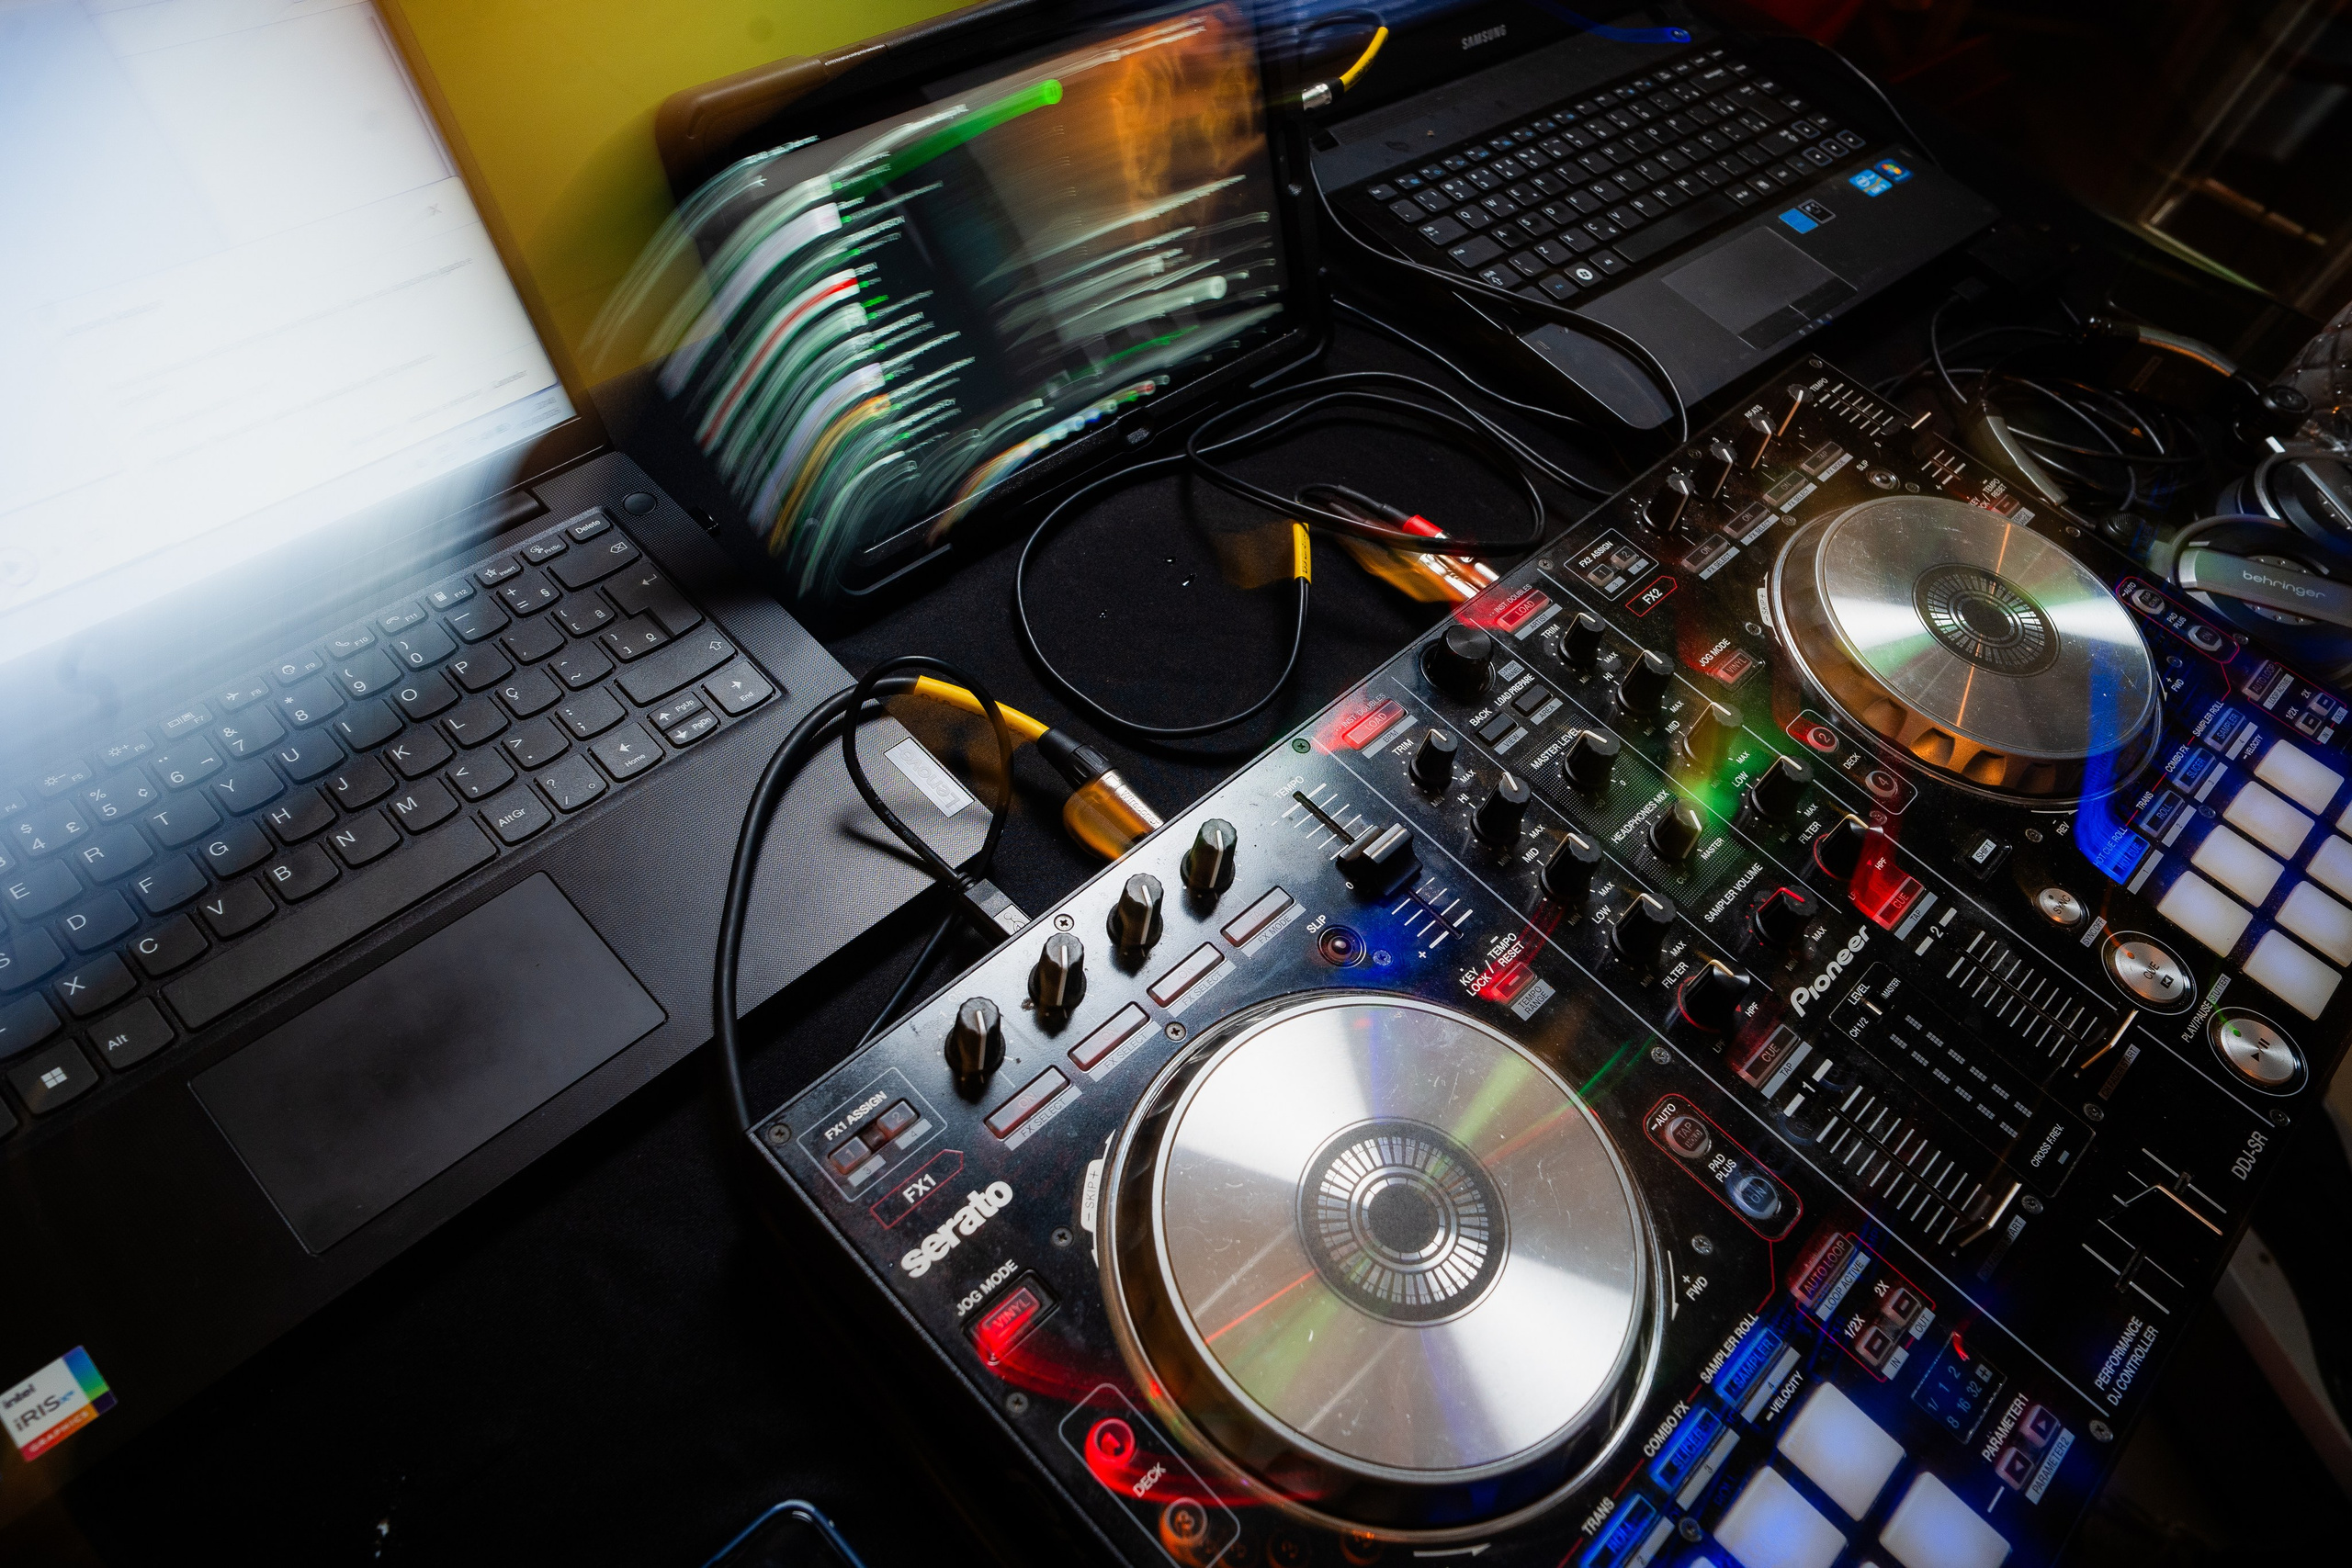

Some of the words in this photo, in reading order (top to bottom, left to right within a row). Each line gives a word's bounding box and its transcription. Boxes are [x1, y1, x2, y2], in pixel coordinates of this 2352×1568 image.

[1462, 25, 1507, 50] SAMSUNG
[1810, 378, 1828, 392] TEMPO
[575, 519, 601, 534] Delete
[544, 543, 561, 554] PrtSc
[1578, 557, 1595, 568] FX2
[1593, 541, 1613, 559] ASSIGN
[499, 566, 515, 576] Insert
[1713, 554, 1732, 568] SELECT
[455, 589, 468, 597] F12
[1508, 583, 1532, 603] DOUBLES
[2243, 570, 2326, 599] behringer
[1643, 588, 1663, 604] FX2
[404, 613, 418, 622] F11
[1514, 600, 1535, 616] LOAD
[1530, 615, 1548, 630] ARTIST
[1541, 625, 1560, 639] TRIM
[355, 636, 368, 647] F10
[1604, 652, 1618, 664] MAX
[1699, 650, 1716, 668] JOG
[1713, 638, 1731, 655] MODE
[455, 661, 468, 674] P
[1725, 658, 1747, 674] VINYL
[1603, 672, 1613, 681] HI
[2171, 679, 2185, 692] FWD
[401, 689, 418, 702] O
[506, 687, 518, 700] Ç
[740, 691, 754, 702] End
[1494, 691, 1510, 706] LOAD
[1510, 673, 1535, 694] PREPARE
[675, 699, 695, 712] PgUp
[1539, 705, 1555, 719] AREA
[449, 718, 465, 729] L
[692, 716, 712, 729] PgDn
[1364, 713, 1387, 730] LOAD
[1469, 708, 1492, 727] BACK
[2192, 714, 2214, 737] SAMPLER
[2212, 701, 2223, 716] ROLL
[1382, 730, 1397, 743] BPM
[1503, 735, 1520, 747] VIEW
[2245, 734, 2264, 756] VELOCITY
[392, 745, 411, 760] K
[1392, 739, 1414, 756] TRIM
[1531, 749, 1559, 769] MASTER
[1558, 728, 1580, 751] LEVEL
[625, 754, 646, 768] Home
[1842, 752, 1861, 770] DECK
[2165, 752, 2185, 773] COMBO
[2180, 745, 2190, 758] FX
[2187, 758, 2205, 779] SLICER
[899, 748, 962, 808] Lenovo
[1459, 770, 1476, 784] MAX
[1272, 774, 1305, 801] TEMPO
[396, 796, 418, 814] M
[1457, 794, 1469, 803] HI
[2135, 791, 2154, 811] TRANS
[498, 807, 526, 826] AltGr
[1611, 801, 1659, 844] HEADPHONES
[1655, 789, 1670, 805] MIX
[2156, 803, 2172, 820] ROLL
[1529, 824, 1545, 839] MAX
[1798, 821, 1821, 844] FILTER
[2056, 821, 2070, 836] REV
[336, 831, 356, 847] N
[2093, 852, 2108, 868] HOT
[2105, 839, 2118, 856] CUE
[2115, 826, 2128, 844] ROLL
[1522, 848, 1539, 863] MID
[1701, 838, 1724, 861] MASTER
[1975, 842, 1994, 861] SHIFT
[1874, 857, 1888, 870] HPF
[1598, 882, 1615, 897] MAX
[1704, 891, 1738, 924] SAMPLER
[1735, 863, 1763, 894] VOLUME
[1893, 893, 1909, 909] CUE
[2053, 895, 2070, 914] SYNC
[1306, 914, 1327, 933] SLIP
[1306, 915, 1327, 933] SLIP
[1591, 905, 1611, 924] LOW
[1909, 909, 1922, 922] TAP
[1258, 931, 1271, 944] FX
[1268, 915, 1292, 937] MODE
[2083, 930, 2097, 945] SYNC
[2094, 919, 2104, 933] OFF
[1487, 932, 1517, 960] TEMPO
[1498, 941, 1525, 967] RESET
[1669, 941, 1687, 957] MAX
[1460, 967, 1479, 987] KEY
[1662, 962, 1690, 988] FILTER
[1791, 925, 1870, 1018] Pioneer
[2143, 961, 2160, 981] CUE
[1465, 973, 1490, 997] LOCK
[1847, 983, 1871, 1006] LEVEL
[1882, 977, 1901, 999] MASTER
[2209, 976, 2228, 1003] STUTTER
[1518, 986, 1543, 1009] TEMPO
[1524, 991, 1549, 1016] RANGE
[1745, 1002, 1759, 1017] HPF
[1849, 1026, 1860, 1038] CH
[1858, 1017, 1870, 1031] 1/2
[2181, 1001, 2212, 1043] PLAY/PAUSE
[107, 1034, 129, 1051] Alt
[1103, 1058, 1118, 1070] FX
[1118, 1032, 1148, 1058] SELECT
[1761, 1043, 1781, 1062] CUE
[1781, 1062, 1793, 1077] TAP
[824, 1124, 847, 1141] FX1
[847, 1090, 888, 1128] ASSIGN
[1020, 1127, 1034, 1138] FX
[1034, 1099, 1066, 1128] SELECT
[1655, 1103, 1677, 1127] AUTO
[1708, 1153, 1726, 1172] PAD
[2030, 1146, 2051, 1168] CROSS
[2232, 1131, 2267, 1180] DDJ-SR
[1715, 1159, 1737, 1183] PLUS
[902, 1174, 937, 1204] FX1
[901, 1181, 1012, 1278] serato
[1824, 1240, 1846, 1267] LOOP
[956, 1288, 984, 1317] JOG
[980, 1259, 1018, 1293] MODE
[1686, 1276, 1708, 1301] FWD
[1825, 1287, 1843, 1312] LOOP
[1838, 1260, 1864, 1291] ACTIVE
[1874, 1280, 1890, 1297] 2X
[991, 1298, 1030, 1328] VINYL
[1844, 1314, 1866, 1339] 1/2X
[1915, 1315, 1930, 1333] OUT
[1700, 1339, 1738, 1384] SAMPLER
[1735, 1314, 1759, 1344] ROLL
[2094, 1315, 2143, 1390] PERFORMANCE
[2107, 1388, 2123, 1406] DJ
[2117, 1325, 2159, 1391] CONTROLLER
[2, 1383, 35, 1409] intel
[1770, 1371, 1804, 1414] VELOCITY
[1644, 1416, 1678, 1458] COMBO
[1672, 1401, 1690, 1424] FX
[1982, 1393, 2029, 1462] PARAMETER1
[2032, 1438, 2068, 1495] PARAMETER2
[1132, 1462, 1166, 1497] DECK
[1581, 1496, 1615, 1537] TRANS
